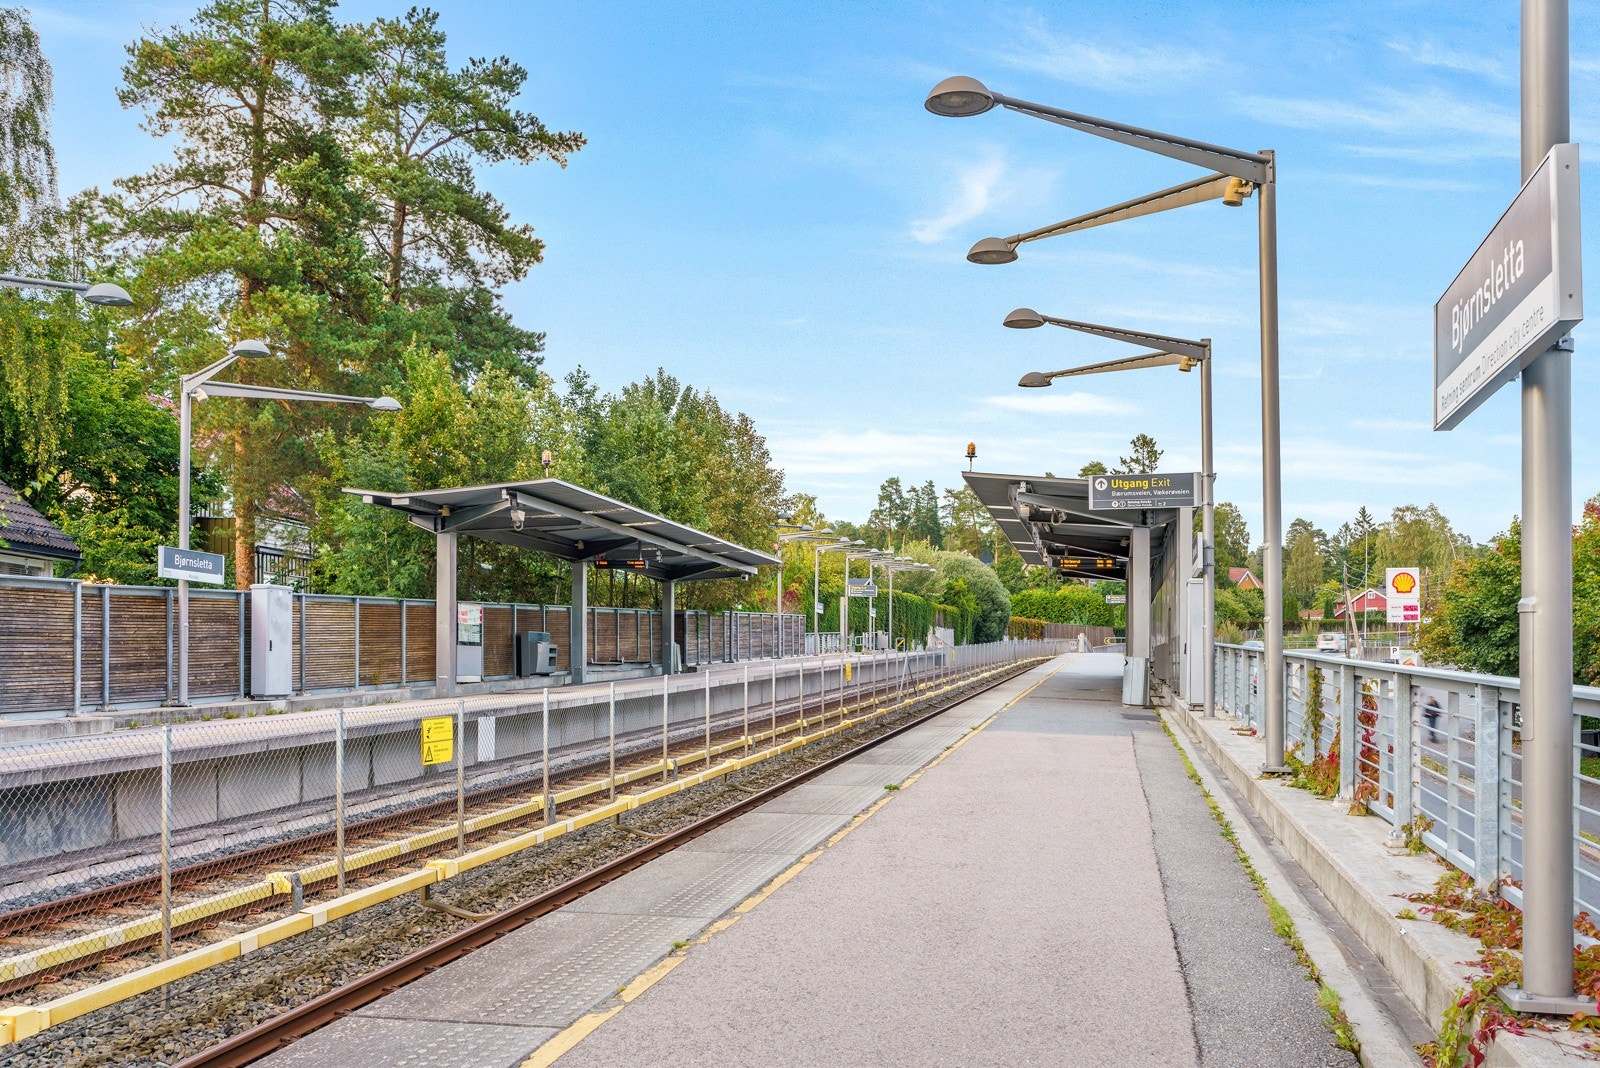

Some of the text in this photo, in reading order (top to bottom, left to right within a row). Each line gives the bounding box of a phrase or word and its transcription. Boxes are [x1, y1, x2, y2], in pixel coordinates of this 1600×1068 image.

[1451, 239, 1525, 355] Bjørnsletta
[1441, 306, 1544, 412] Retning sentrum Direction city centre
[1111, 477, 1171, 490] Utgang Exit
[174, 554, 213, 570] Bjørnsletta
